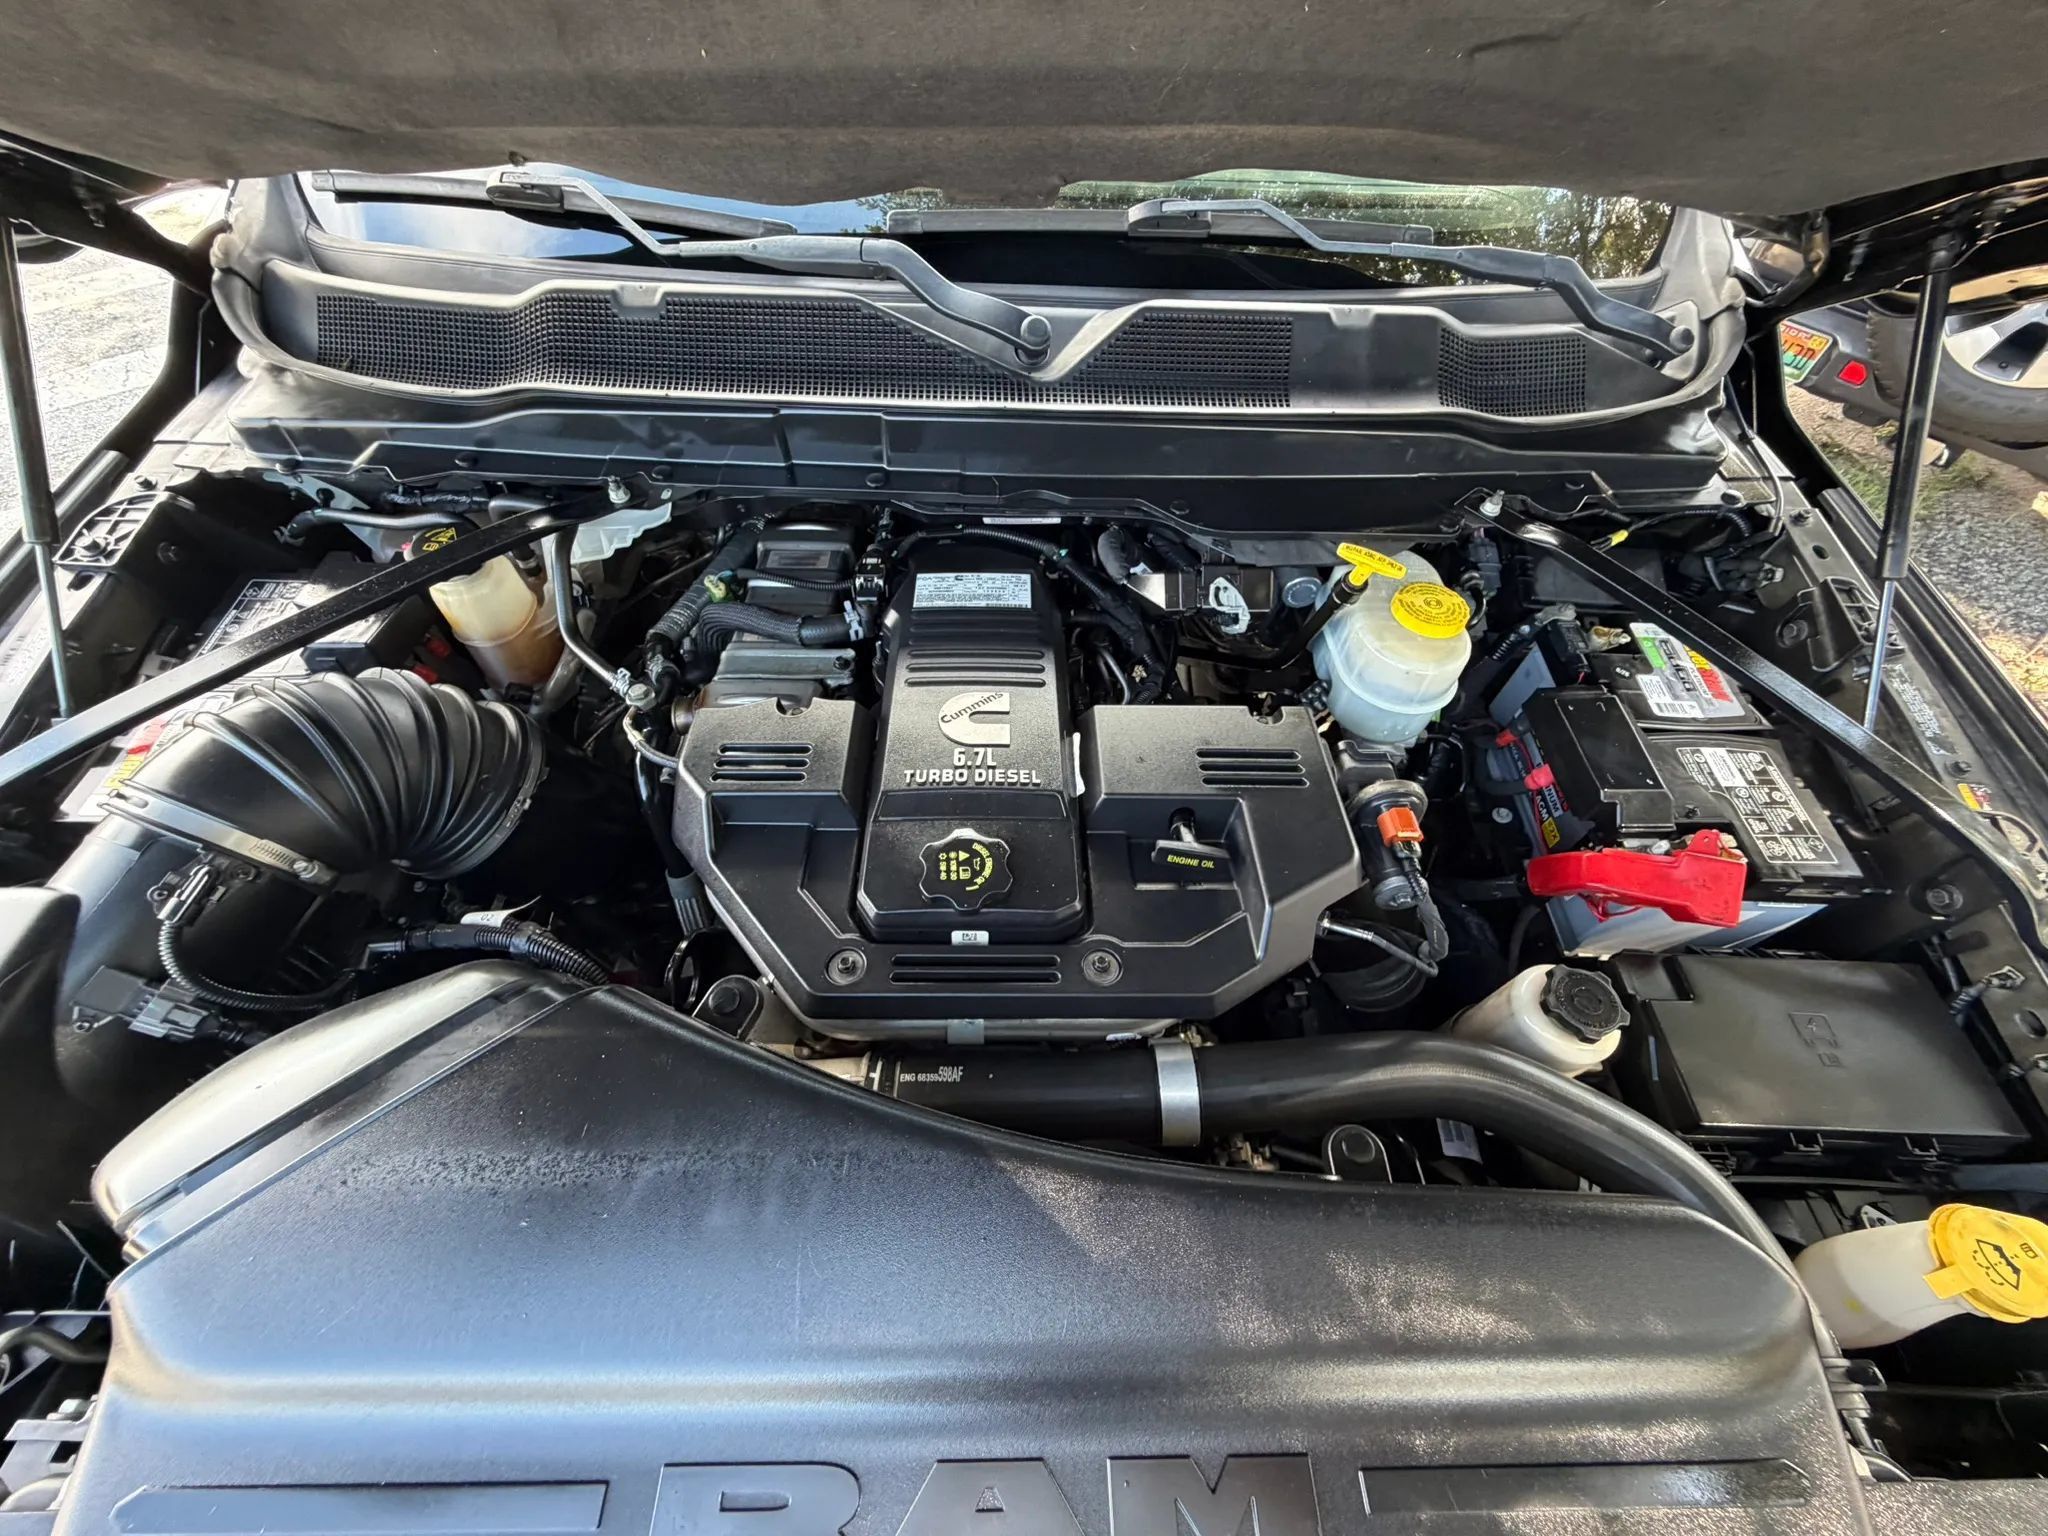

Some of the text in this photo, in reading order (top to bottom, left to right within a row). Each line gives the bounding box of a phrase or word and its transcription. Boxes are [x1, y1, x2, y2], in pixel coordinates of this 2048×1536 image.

[940, 692, 1004, 724] Cummins
[953, 748, 997, 767] 6.7L
[904, 768, 1042, 786] TURBO DIESEL
[1167, 854, 1215, 868] ENGINE OIL
[900, 1073, 916, 1083] ENG
[649, 1452, 1324, 1536] RAM
